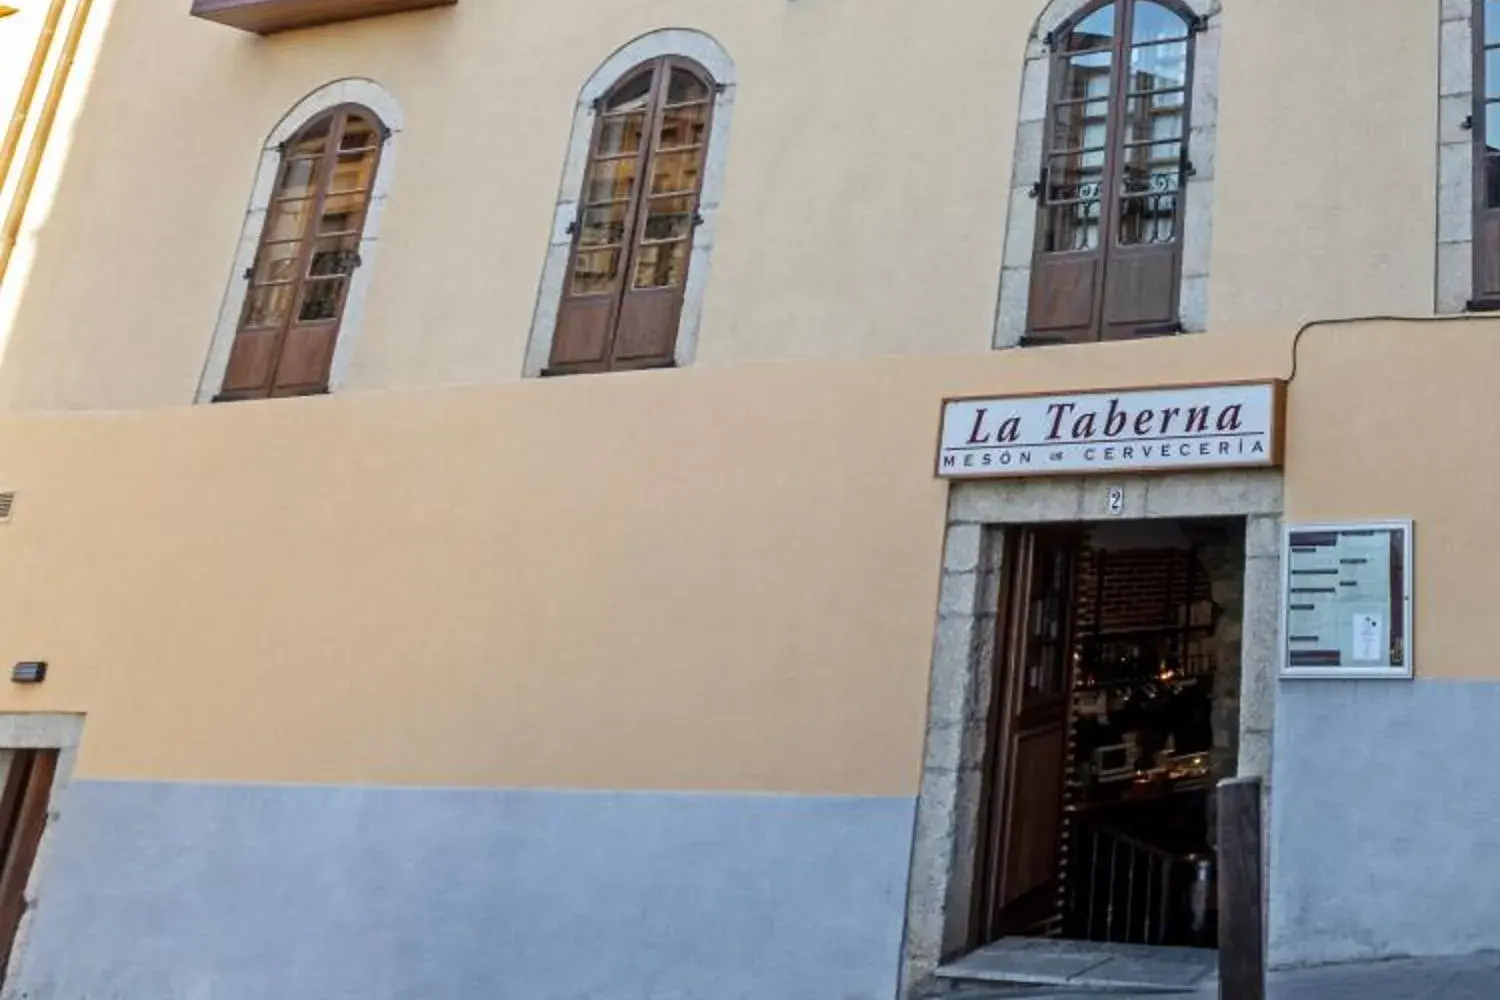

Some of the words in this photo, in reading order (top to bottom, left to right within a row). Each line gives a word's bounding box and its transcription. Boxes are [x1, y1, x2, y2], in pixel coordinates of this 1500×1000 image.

[966, 408, 1021, 444] La
[1045, 398, 1243, 440] Taberna
[943, 450, 1031, 467] MESÓN
[1083, 438, 1264, 461] CERVECERÍA
[1111, 490, 1121, 509] 2
